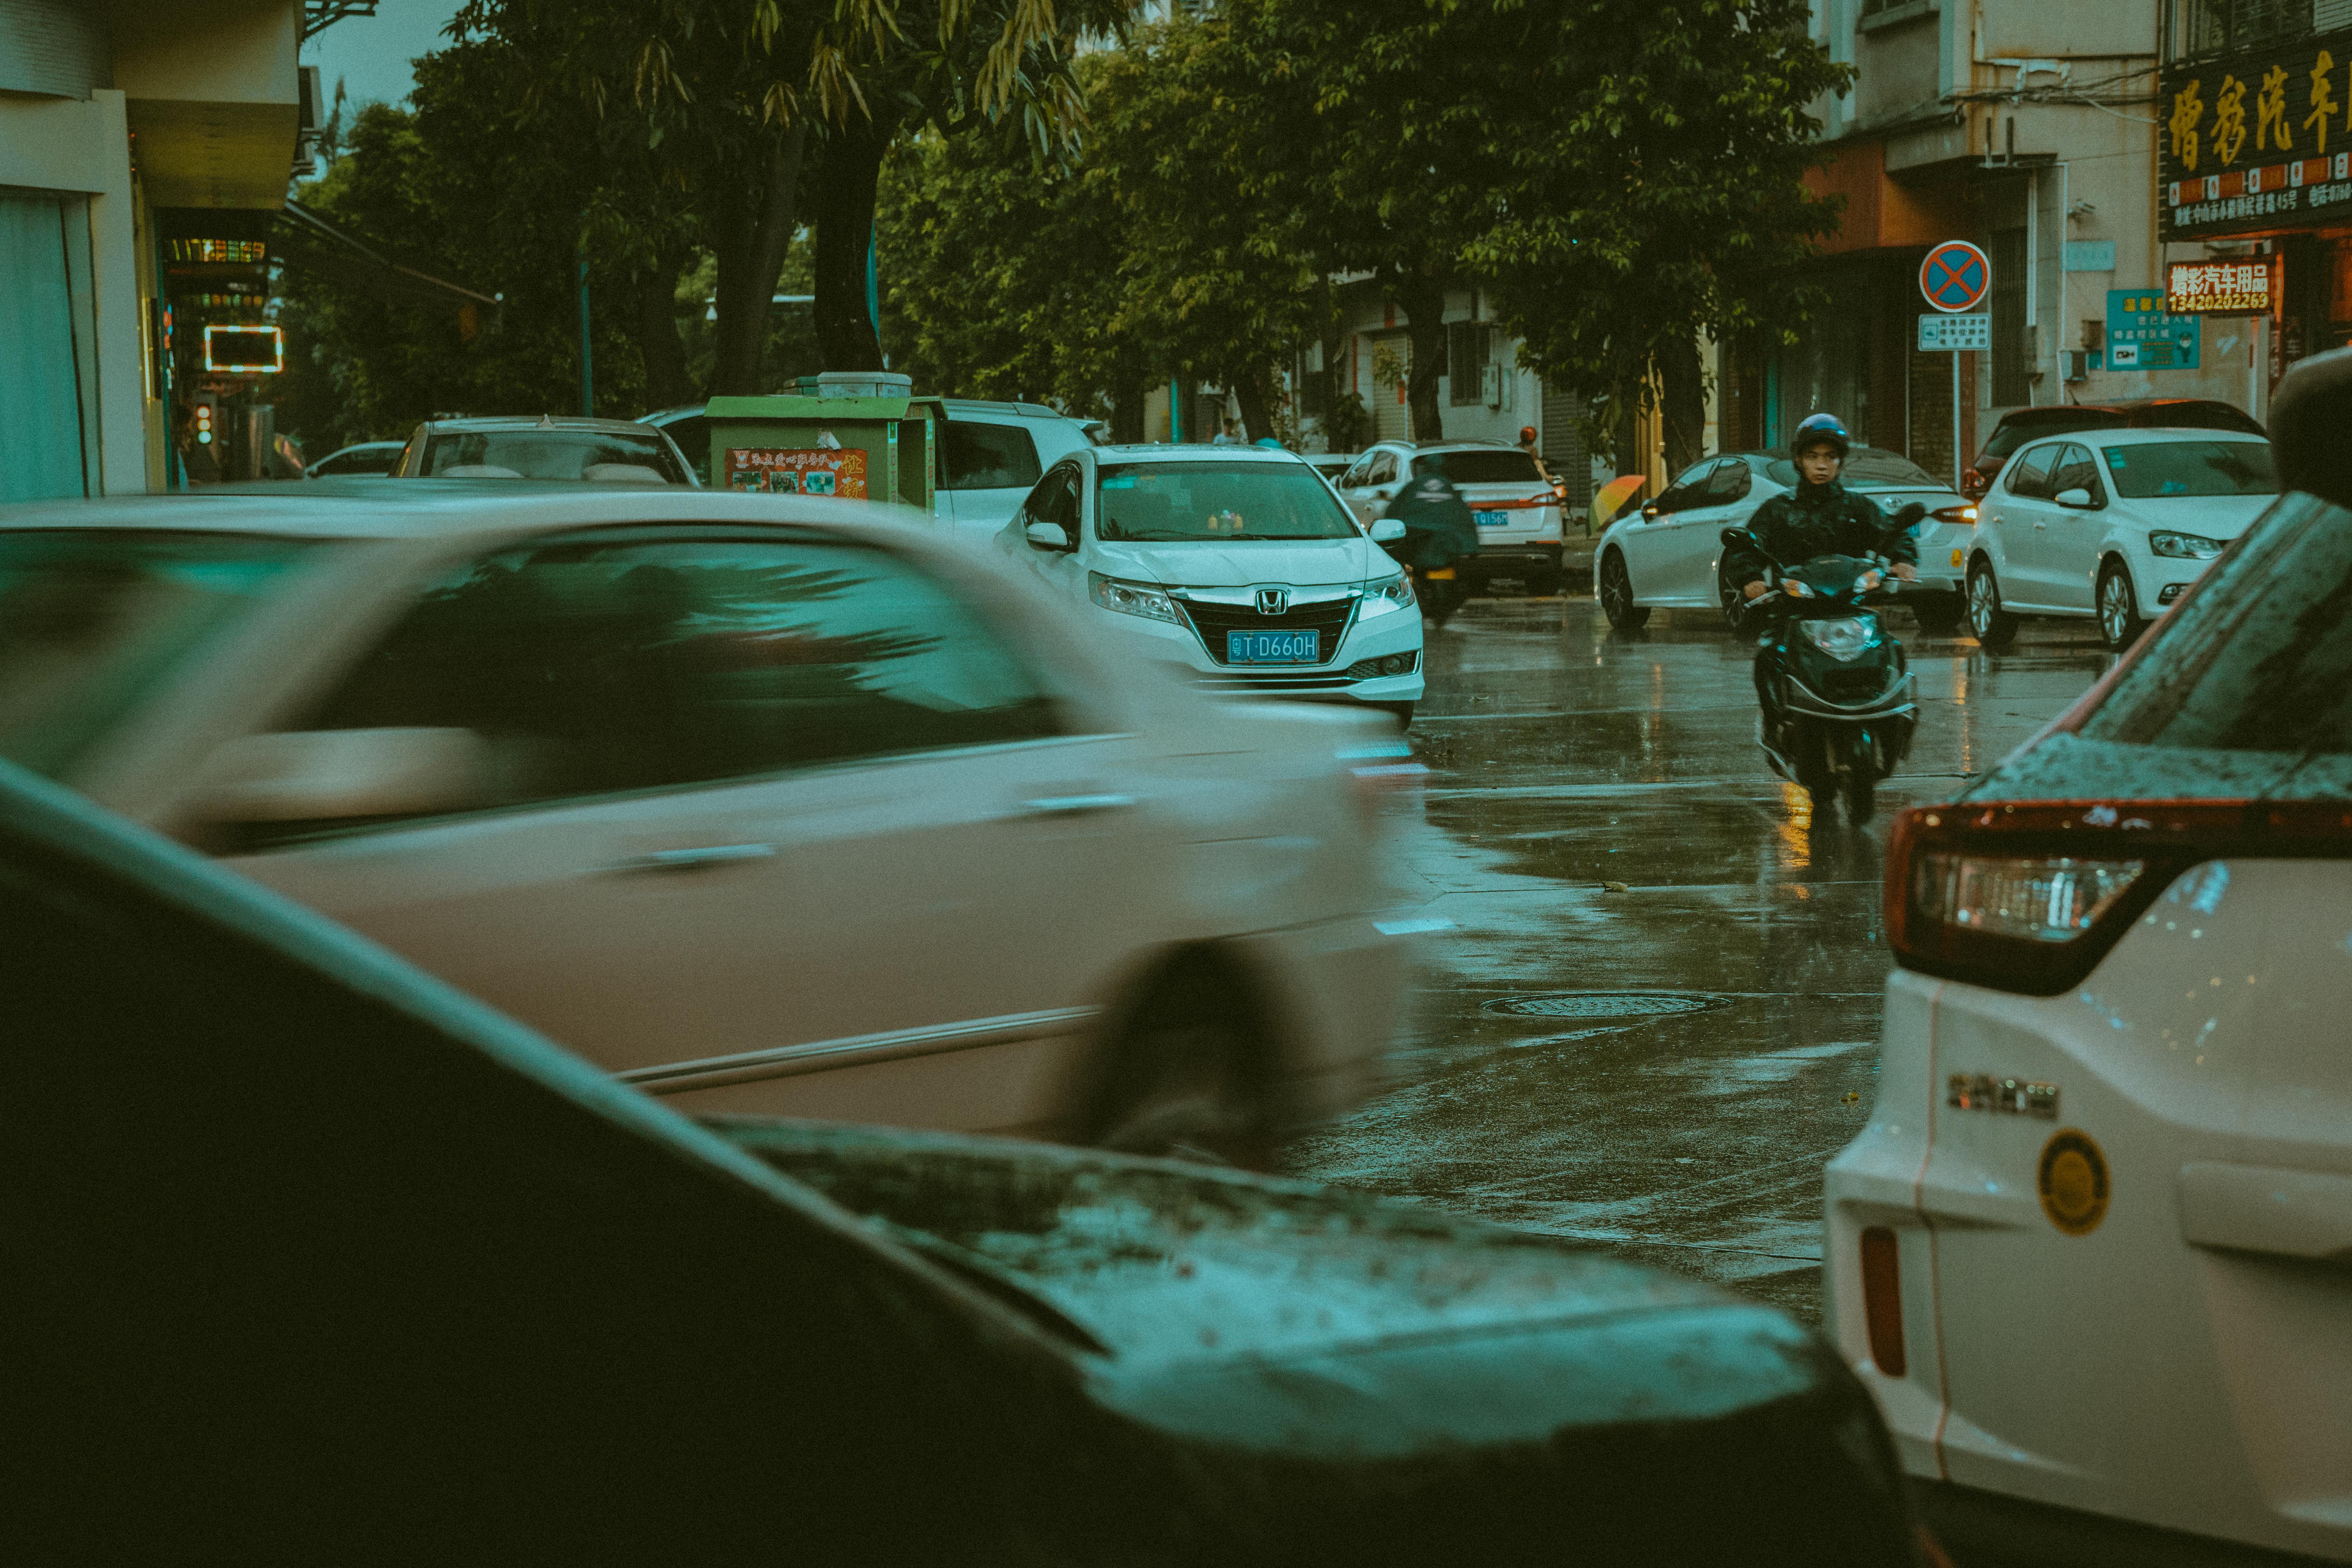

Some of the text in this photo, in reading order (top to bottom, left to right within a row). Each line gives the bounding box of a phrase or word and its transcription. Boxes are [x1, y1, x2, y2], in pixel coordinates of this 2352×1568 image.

[2169, 51, 2352, 171] 增彩汽车
[2171, 265, 2268, 296] 增彩汽车用品
[2169, 292, 2269, 312] 13420202269
